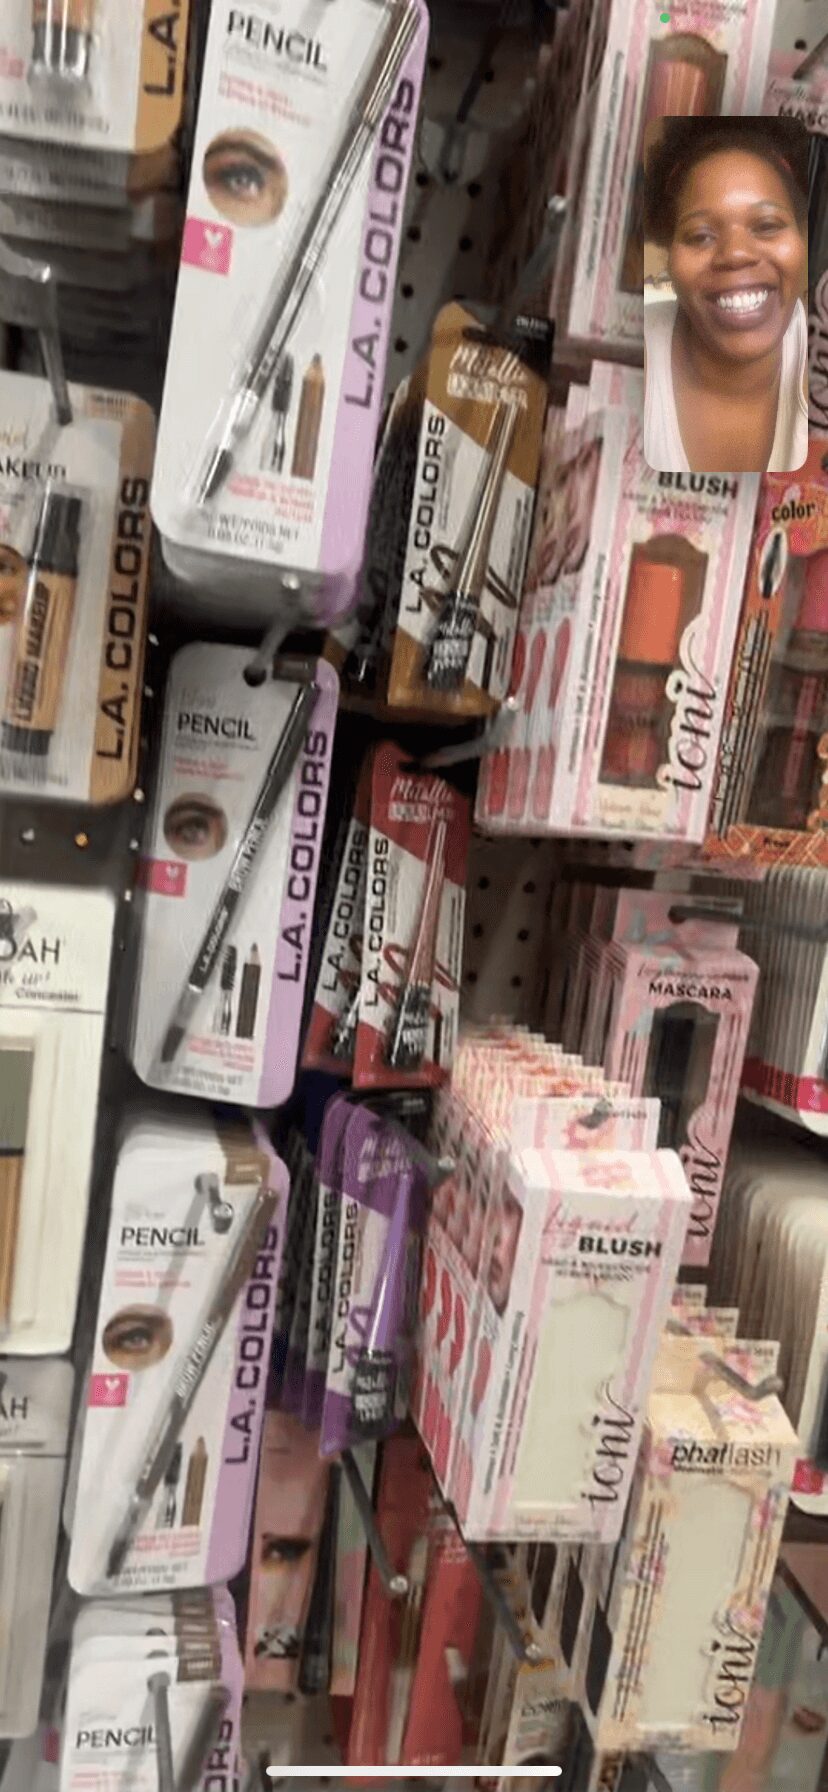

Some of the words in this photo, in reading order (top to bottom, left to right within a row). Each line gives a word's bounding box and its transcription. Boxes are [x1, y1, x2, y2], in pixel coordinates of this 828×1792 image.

[227, 10, 327, 73] PENCIL
[359, 77, 416, 303] COLORS
[413, 414, 446, 550] COLORS
[658, 471, 739, 500] BLUSH
[772, 500, 816, 522] color
[105, 477, 149, 671] COLORS
[96, 682, 130, 761] L.A.
[177, 711, 257, 741] PENCIL
[287, 729, 328, 902] COLORS
[332, 829, 368, 940] COLORS
[367, 837, 389, 951] COLORS
[277, 911, 308, 982] L.A.
[648, 981, 733, 1001] MASCARA
[120, 1226, 205, 1248] PENCIL
[338, 1203, 359, 1317] COLORS
[578, 1235, 663, 1259] BLUSH
[236, 1225, 279, 1390] COLORS
[224, 1399, 256, 1465] L.A.
[671, 1440, 782, 1466] phatlash
